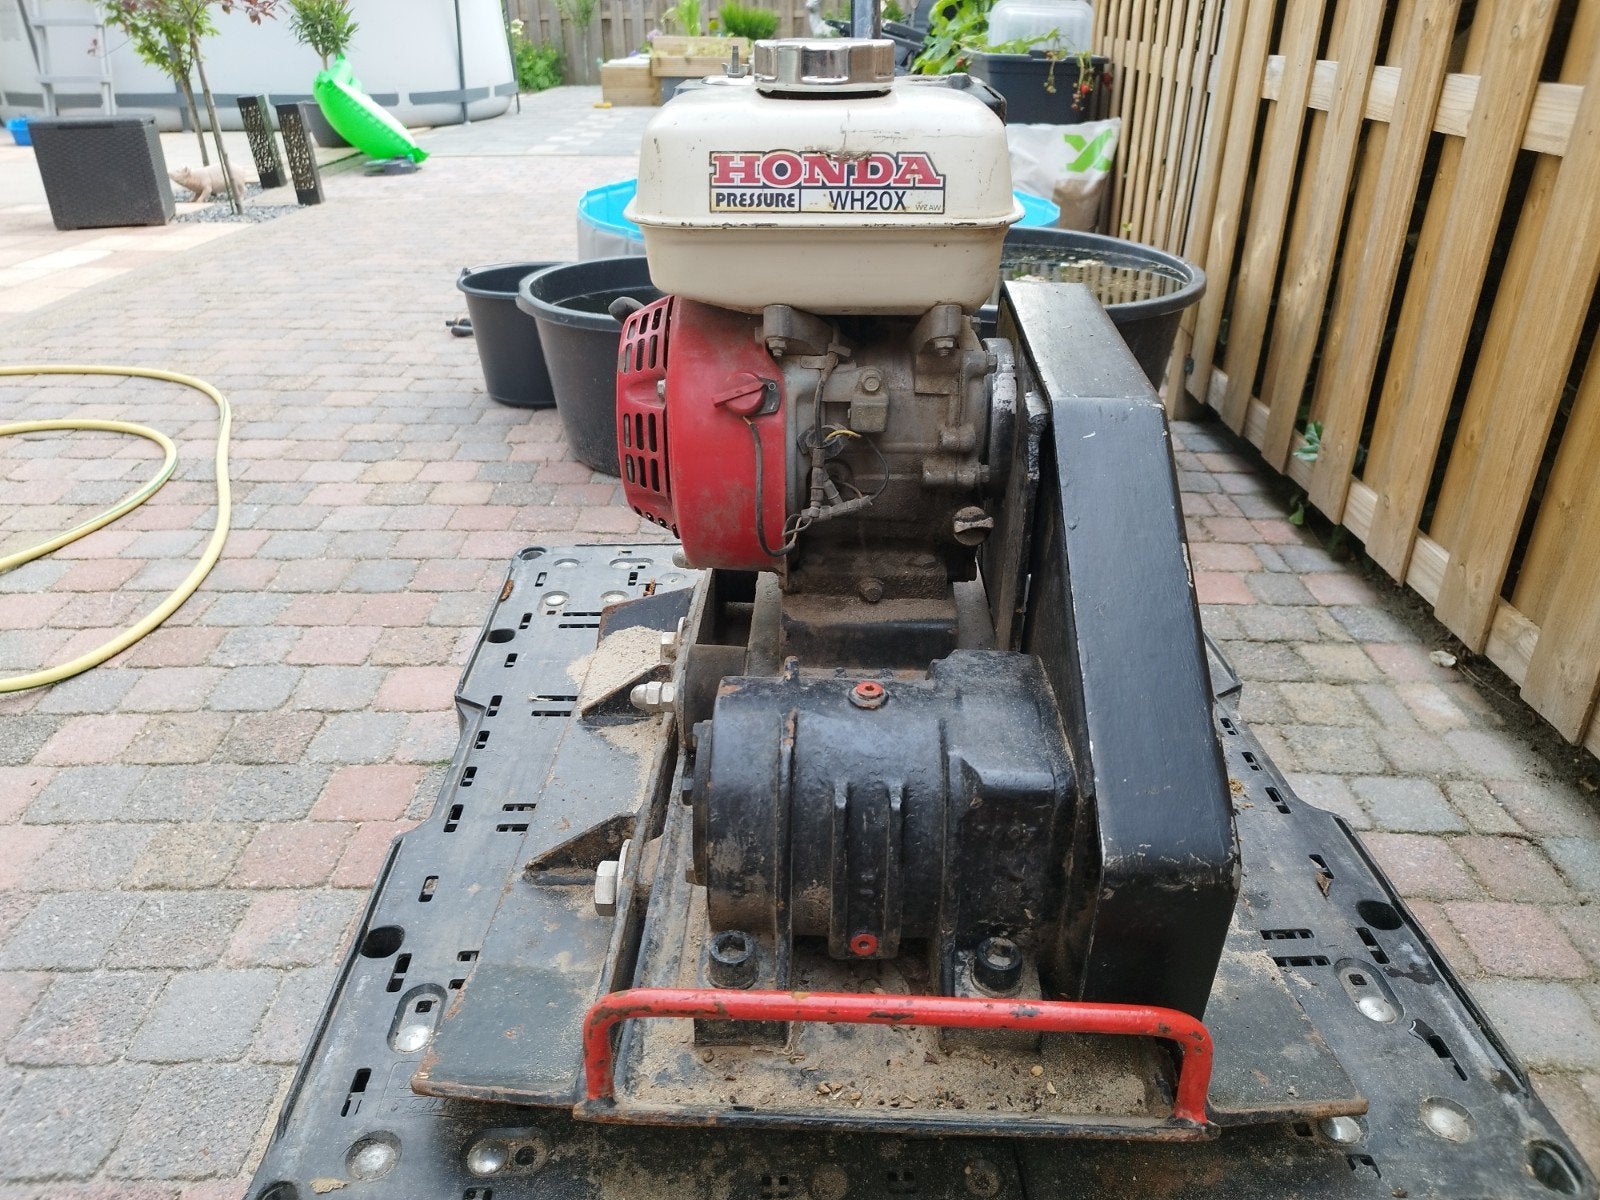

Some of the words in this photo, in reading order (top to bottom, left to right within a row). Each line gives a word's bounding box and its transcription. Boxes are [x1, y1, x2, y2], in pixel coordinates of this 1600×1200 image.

[712, 152, 942, 186] HONDA
[715, 192, 796, 208] PRESSURE
[829, 191, 907, 211] WH20X
